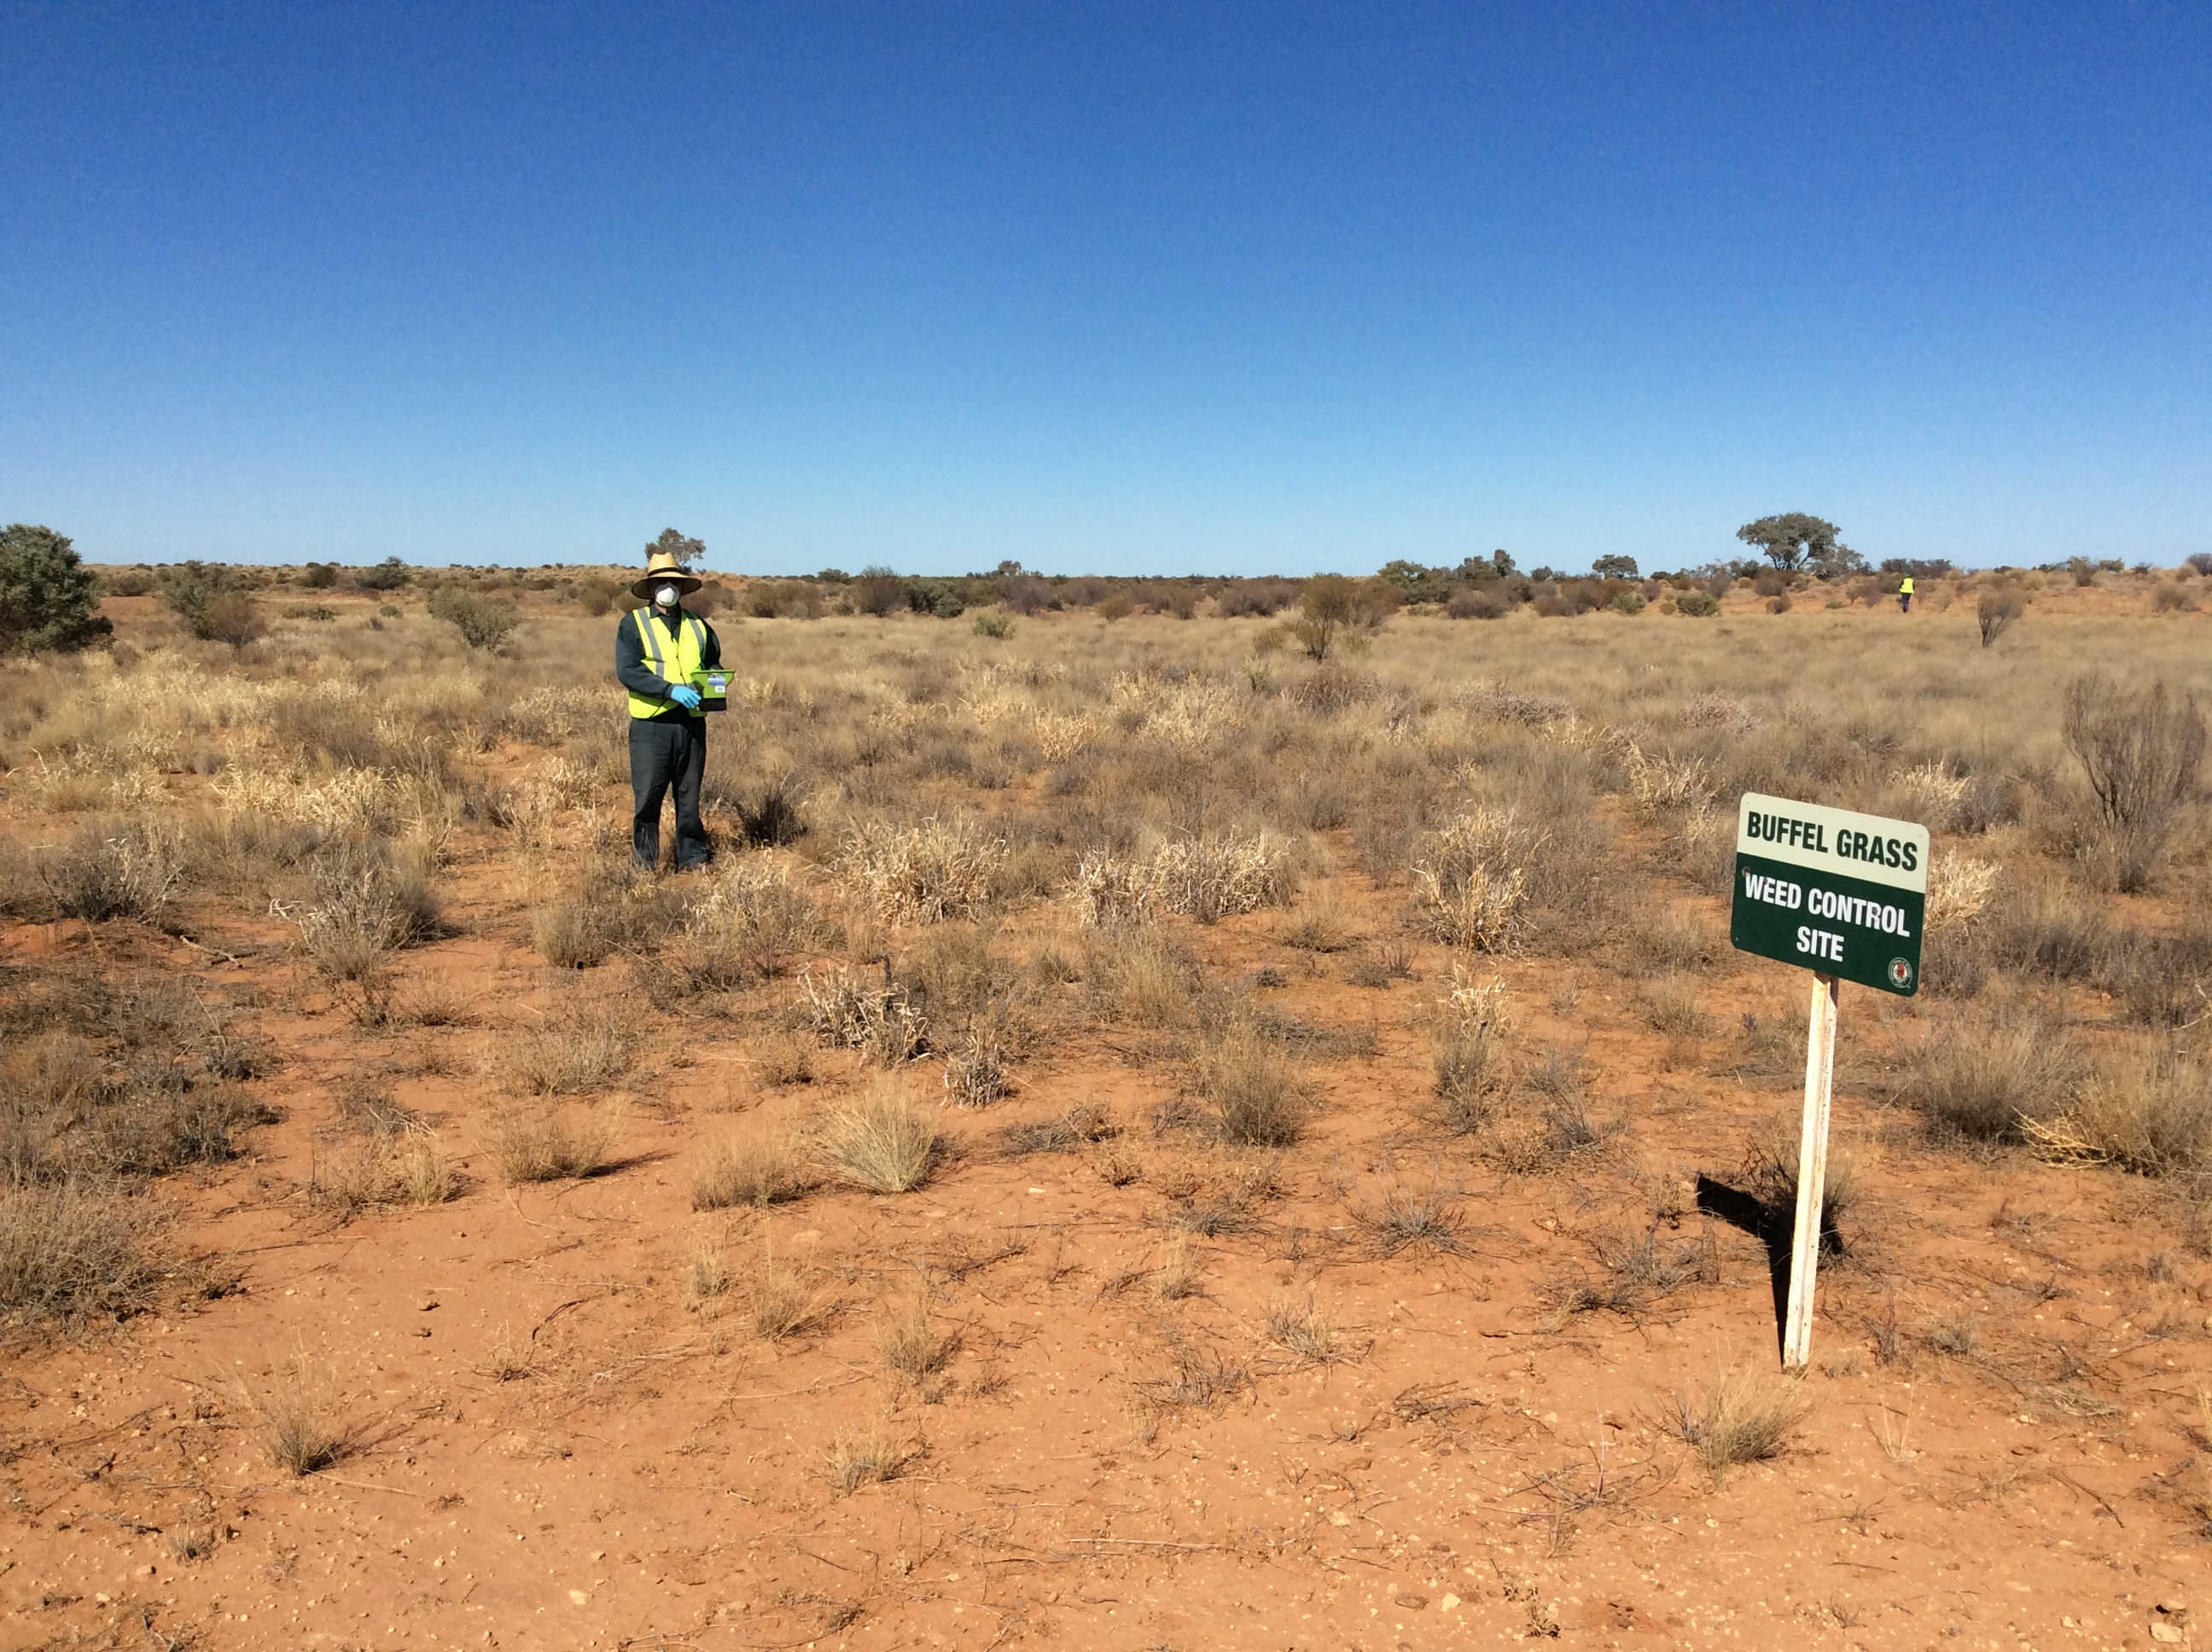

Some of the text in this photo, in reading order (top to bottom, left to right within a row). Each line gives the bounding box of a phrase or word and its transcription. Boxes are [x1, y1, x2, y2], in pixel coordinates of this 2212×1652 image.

[1747, 811, 1918, 871] BUFFEL GRASS
[1744, 872, 1911, 937] WEED CONTROL
[1796, 926, 1844, 962] SITE
